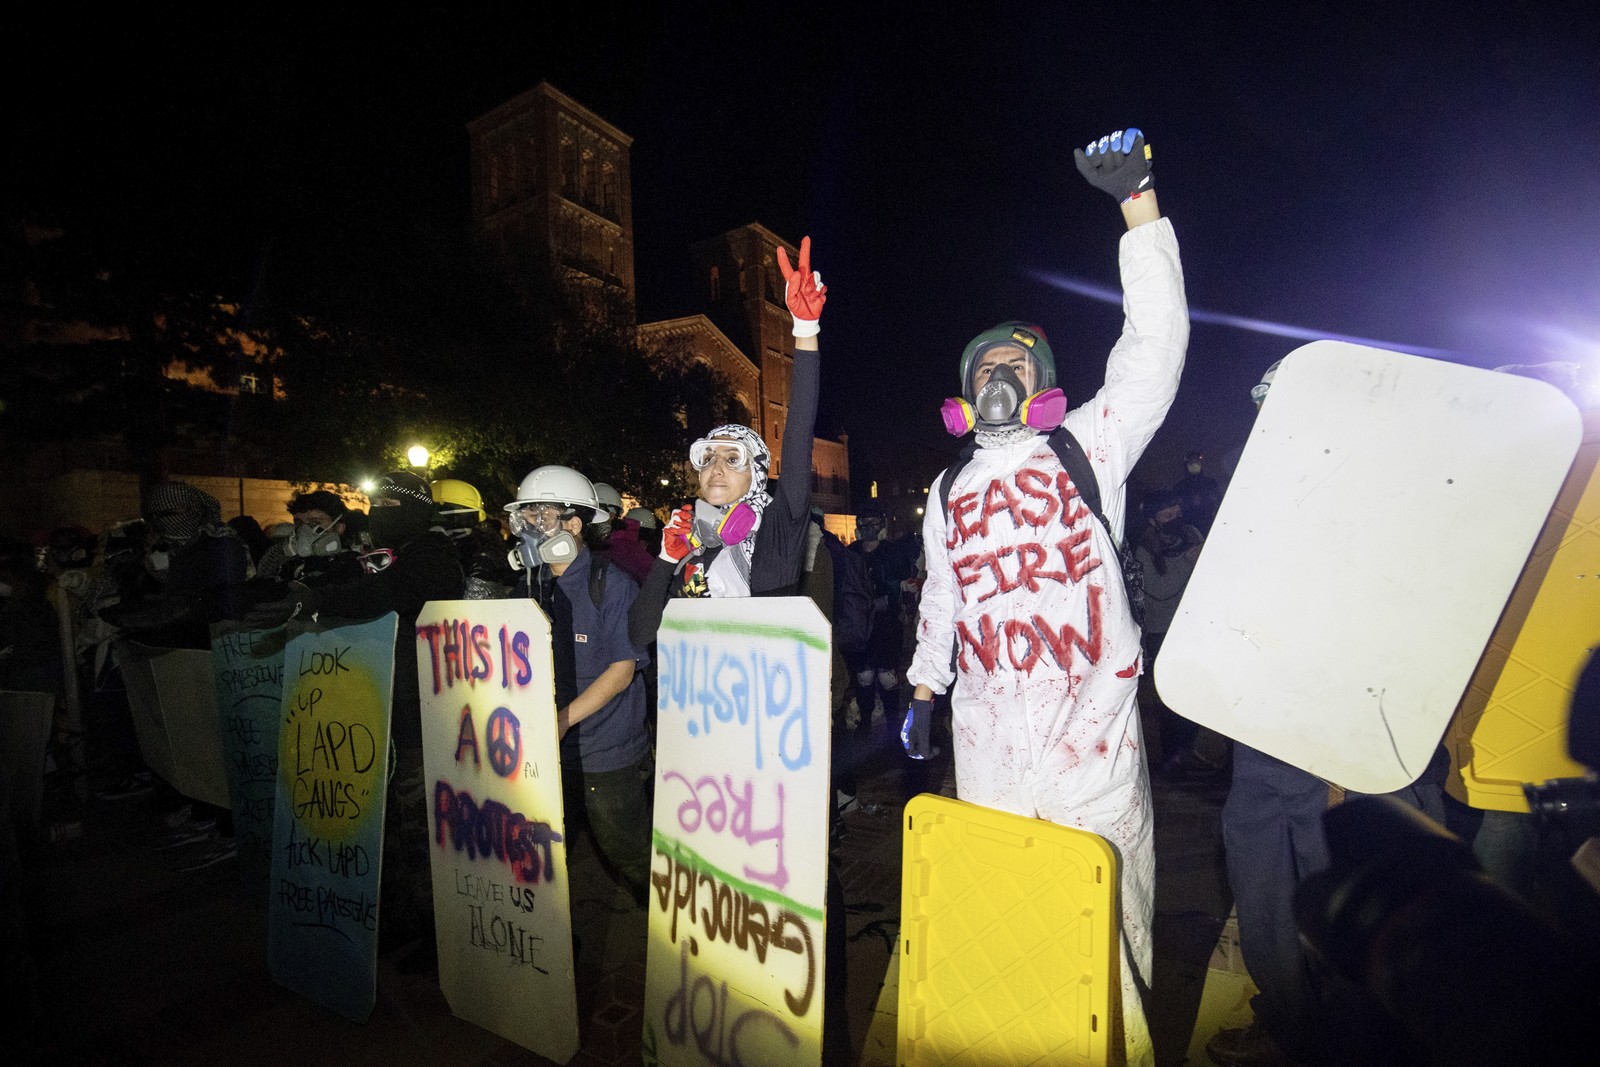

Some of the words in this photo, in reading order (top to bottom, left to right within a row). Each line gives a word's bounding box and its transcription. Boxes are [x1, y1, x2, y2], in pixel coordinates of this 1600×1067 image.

[952, 529, 1103, 603] FIRE
[220, 631, 261, 664] FREE
[300, 647, 351, 676] LOOK
[416, 619, 493, 695] THIS
[499, 624, 532, 691] IS
[955, 584, 1104, 684] NOW
[455, 704, 481, 773] A
[656, 639, 811, 771] Palestine
[434, 779, 562, 885] PROTEST
[455, 868, 504, 905] LEAVE
[509, 886, 535, 913] US
[469, 904, 549, 975] ALONE
[652, 844, 816, 1017] Genocide
